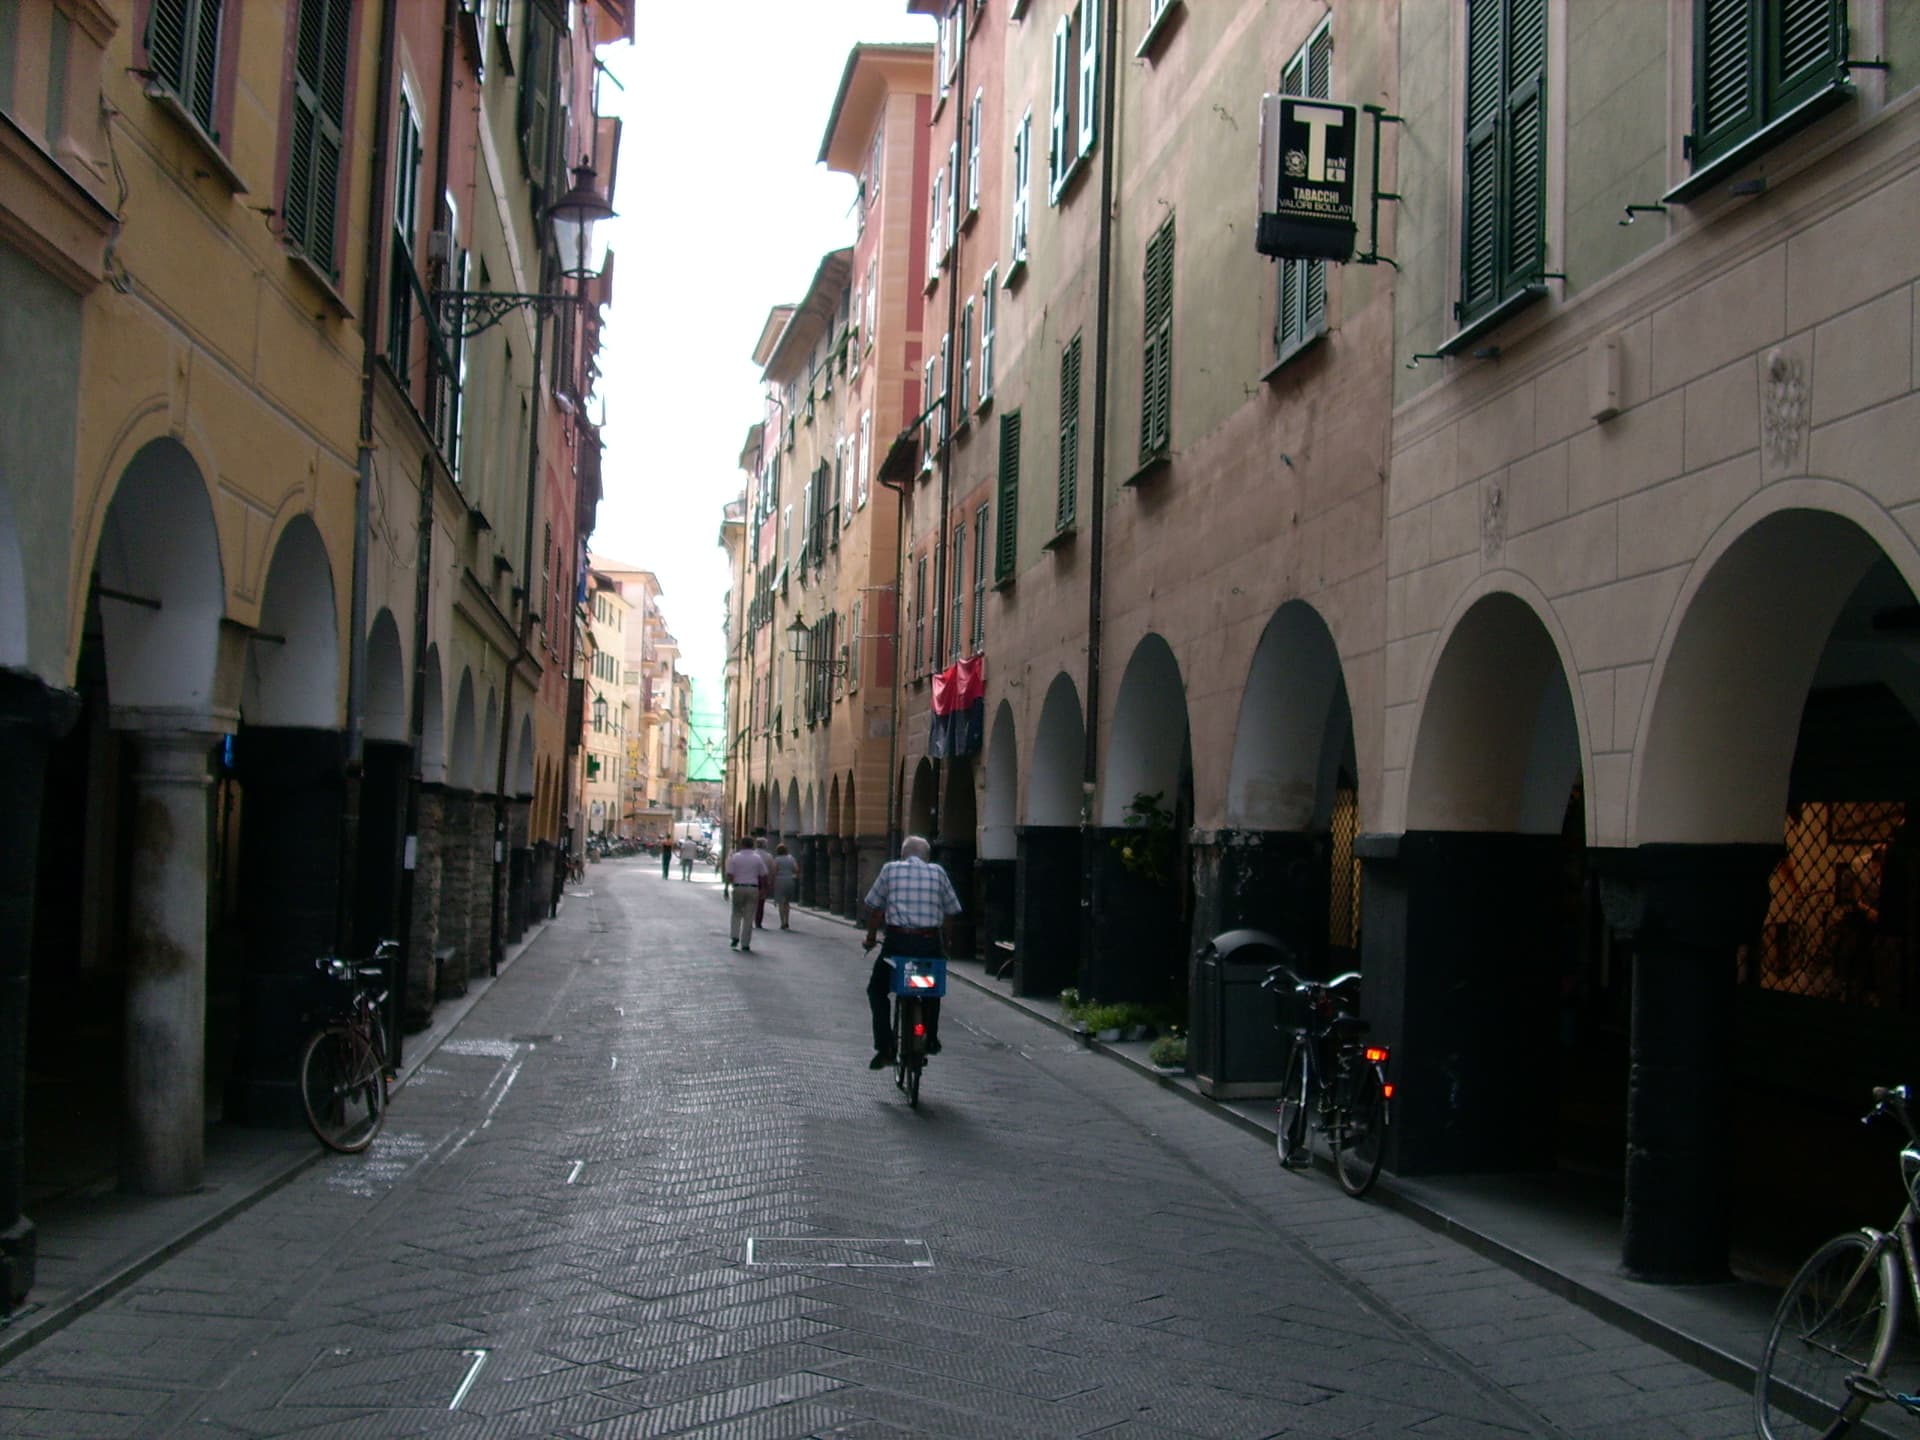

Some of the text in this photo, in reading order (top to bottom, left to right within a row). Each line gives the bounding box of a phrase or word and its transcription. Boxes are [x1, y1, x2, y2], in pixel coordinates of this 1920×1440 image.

[1293, 106, 1343, 181] T
[1293, 187, 1339, 203] TABACCHI
[1279, 199, 1353, 214] VALORI BOLLATI
